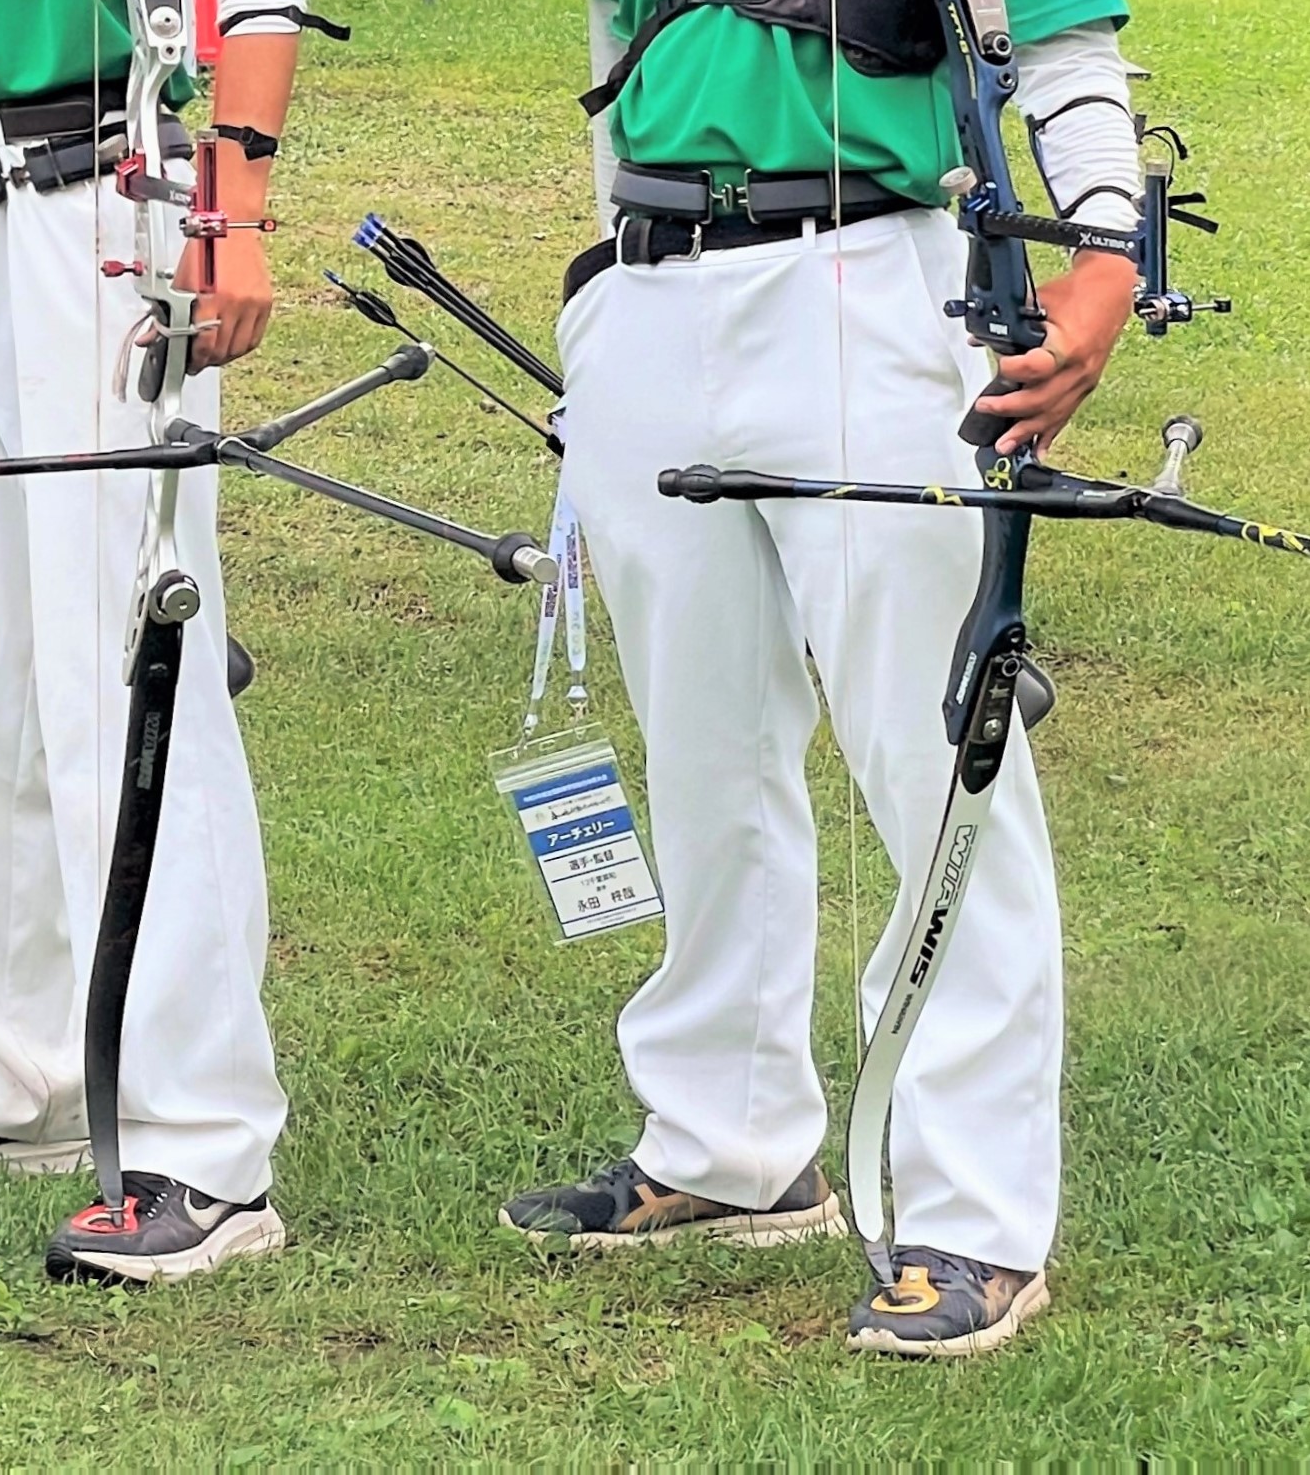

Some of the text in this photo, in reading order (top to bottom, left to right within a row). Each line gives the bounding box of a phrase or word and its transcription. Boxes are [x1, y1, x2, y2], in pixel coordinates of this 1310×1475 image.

[547, 820, 615, 847] アーチェリー
[910, 823, 974, 989] WIAWIS
